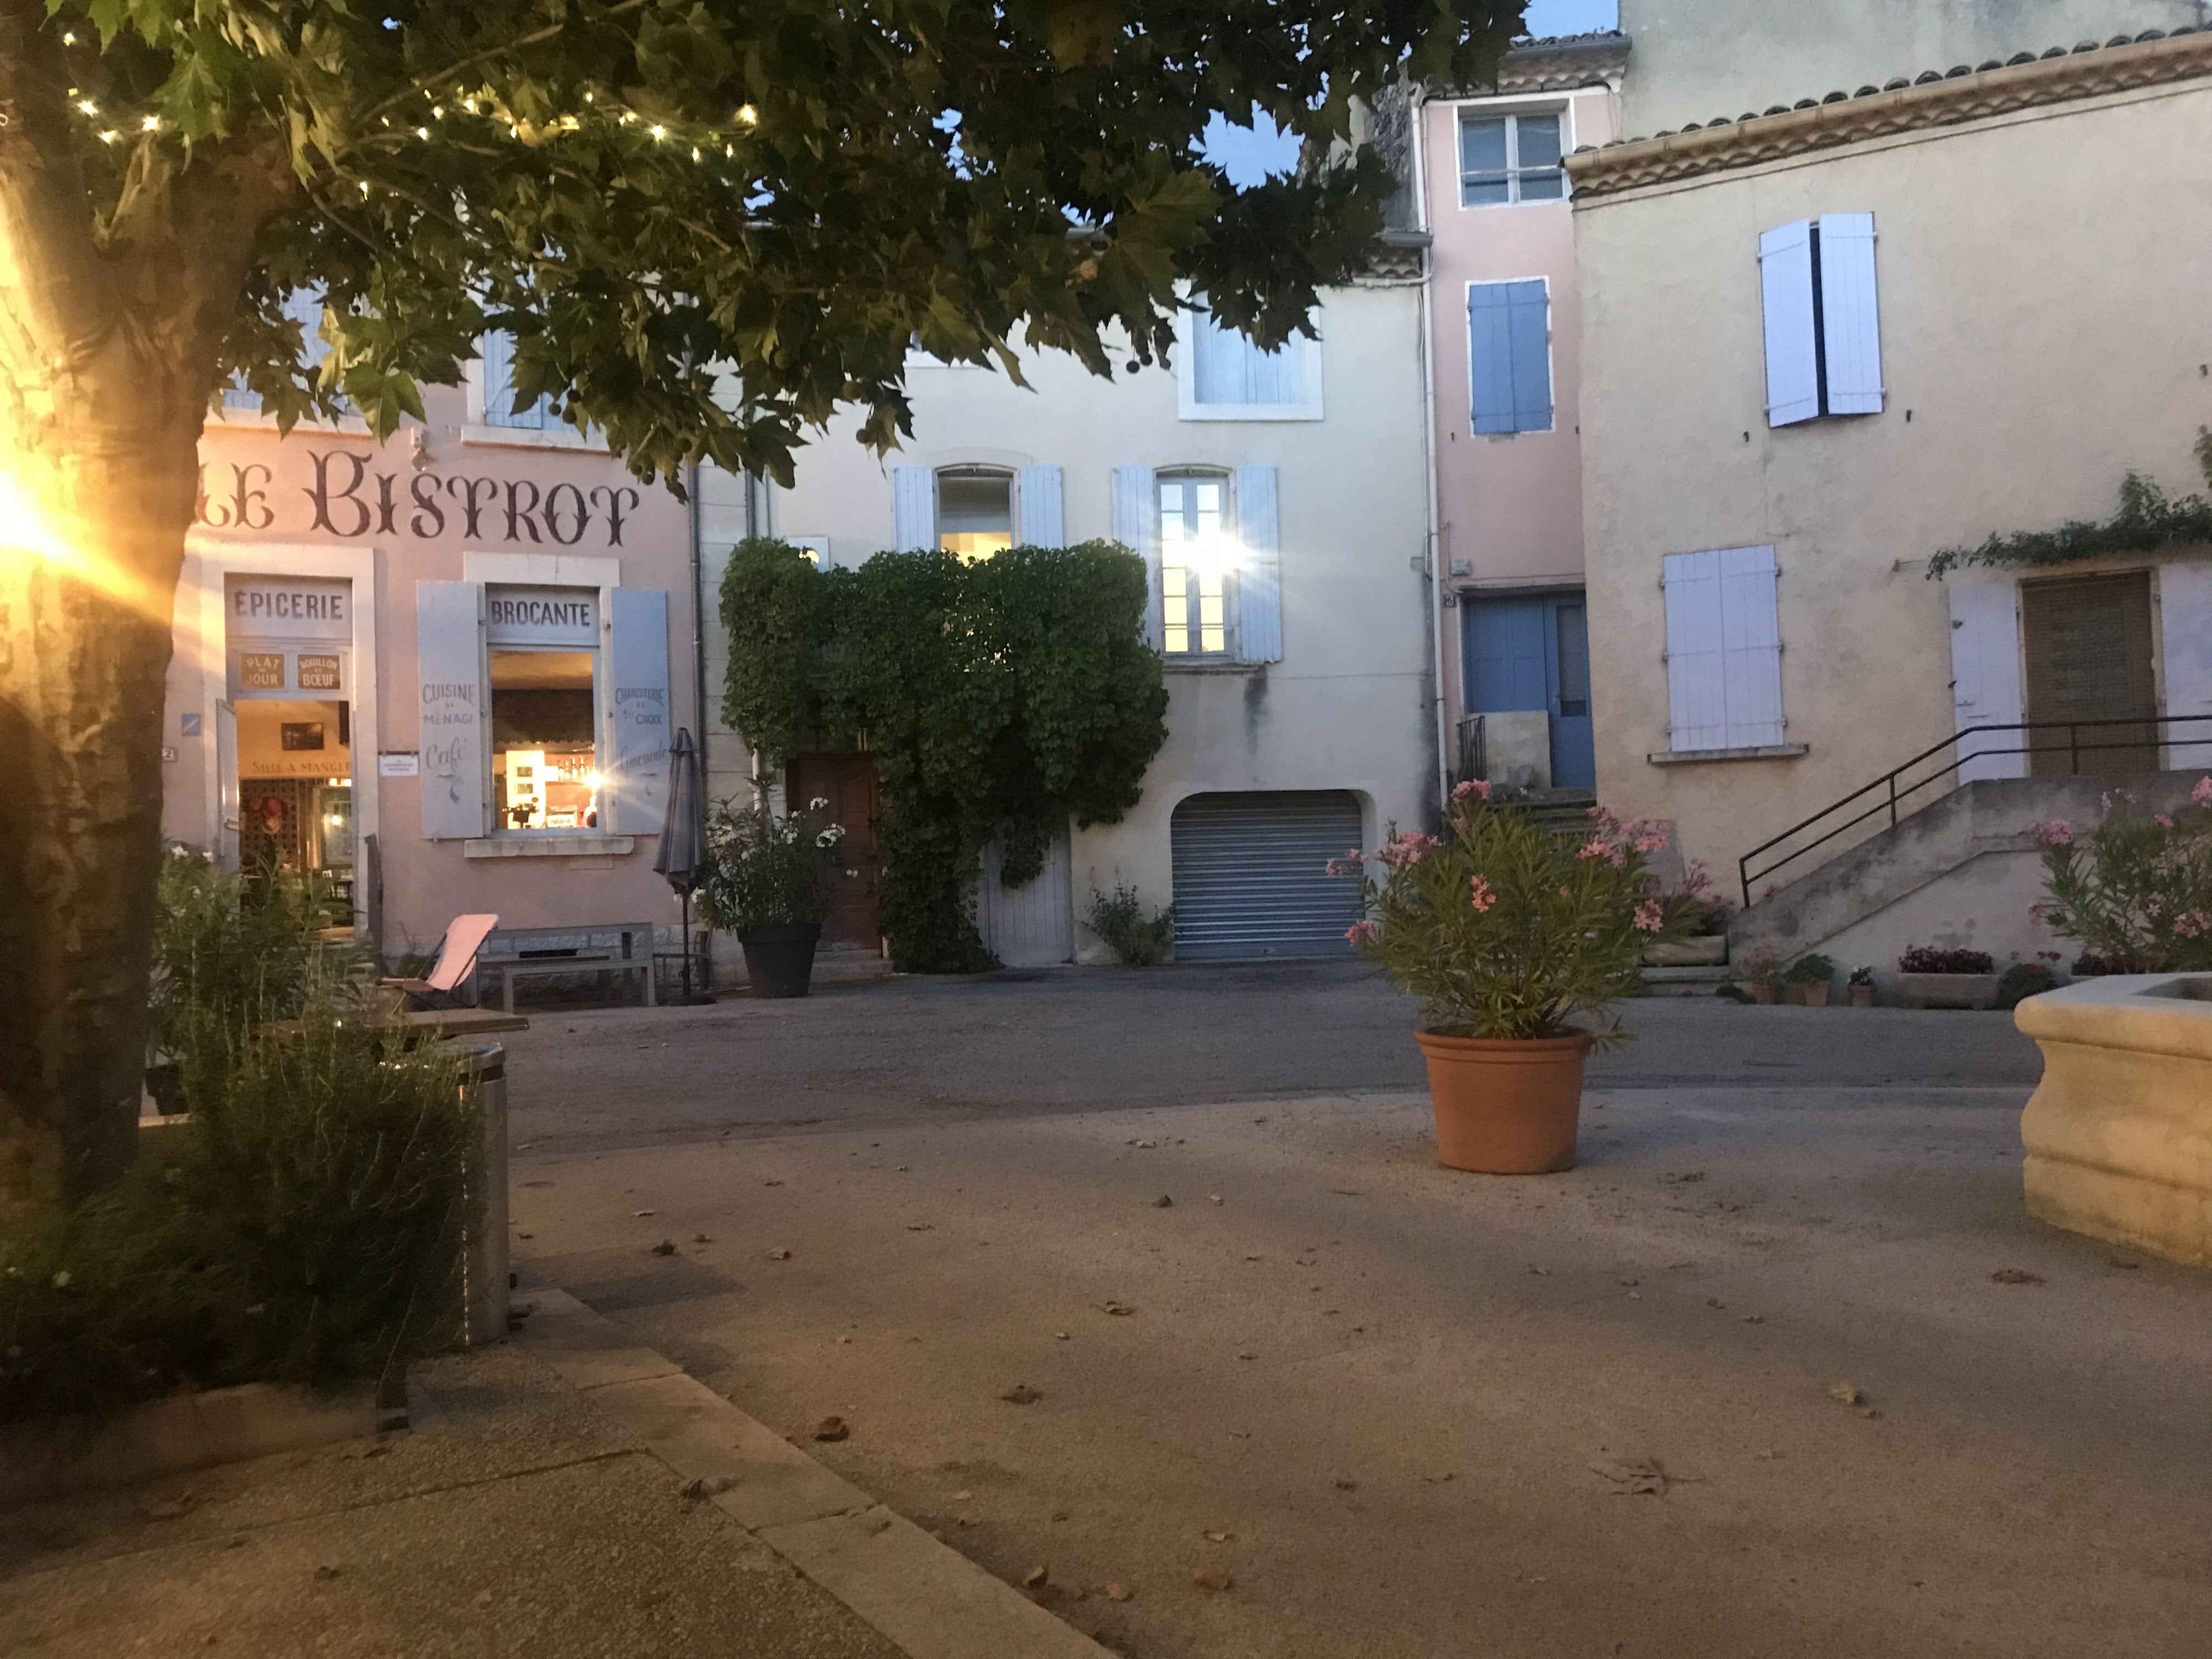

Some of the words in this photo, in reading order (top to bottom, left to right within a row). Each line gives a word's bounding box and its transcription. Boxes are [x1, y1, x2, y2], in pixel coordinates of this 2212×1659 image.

[193, 461, 274, 529] LE
[302, 449, 640, 547] BISTROT
[234, 590, 343, 619] ÉPICERIE
[492, 601, 590, 627] BROCANTE
[246, 656, 280, 669] PLAT
[300, 658, 338, 670] BOUILLON
[245, 673, 279, 685] JOUR
[422, 684, 475, 707] CUISINE
[616, 687, 665, 707] CHARCUTERIE
[635, 714, 663, 724] CHOIX
[426, 736, 468, 772] Café
